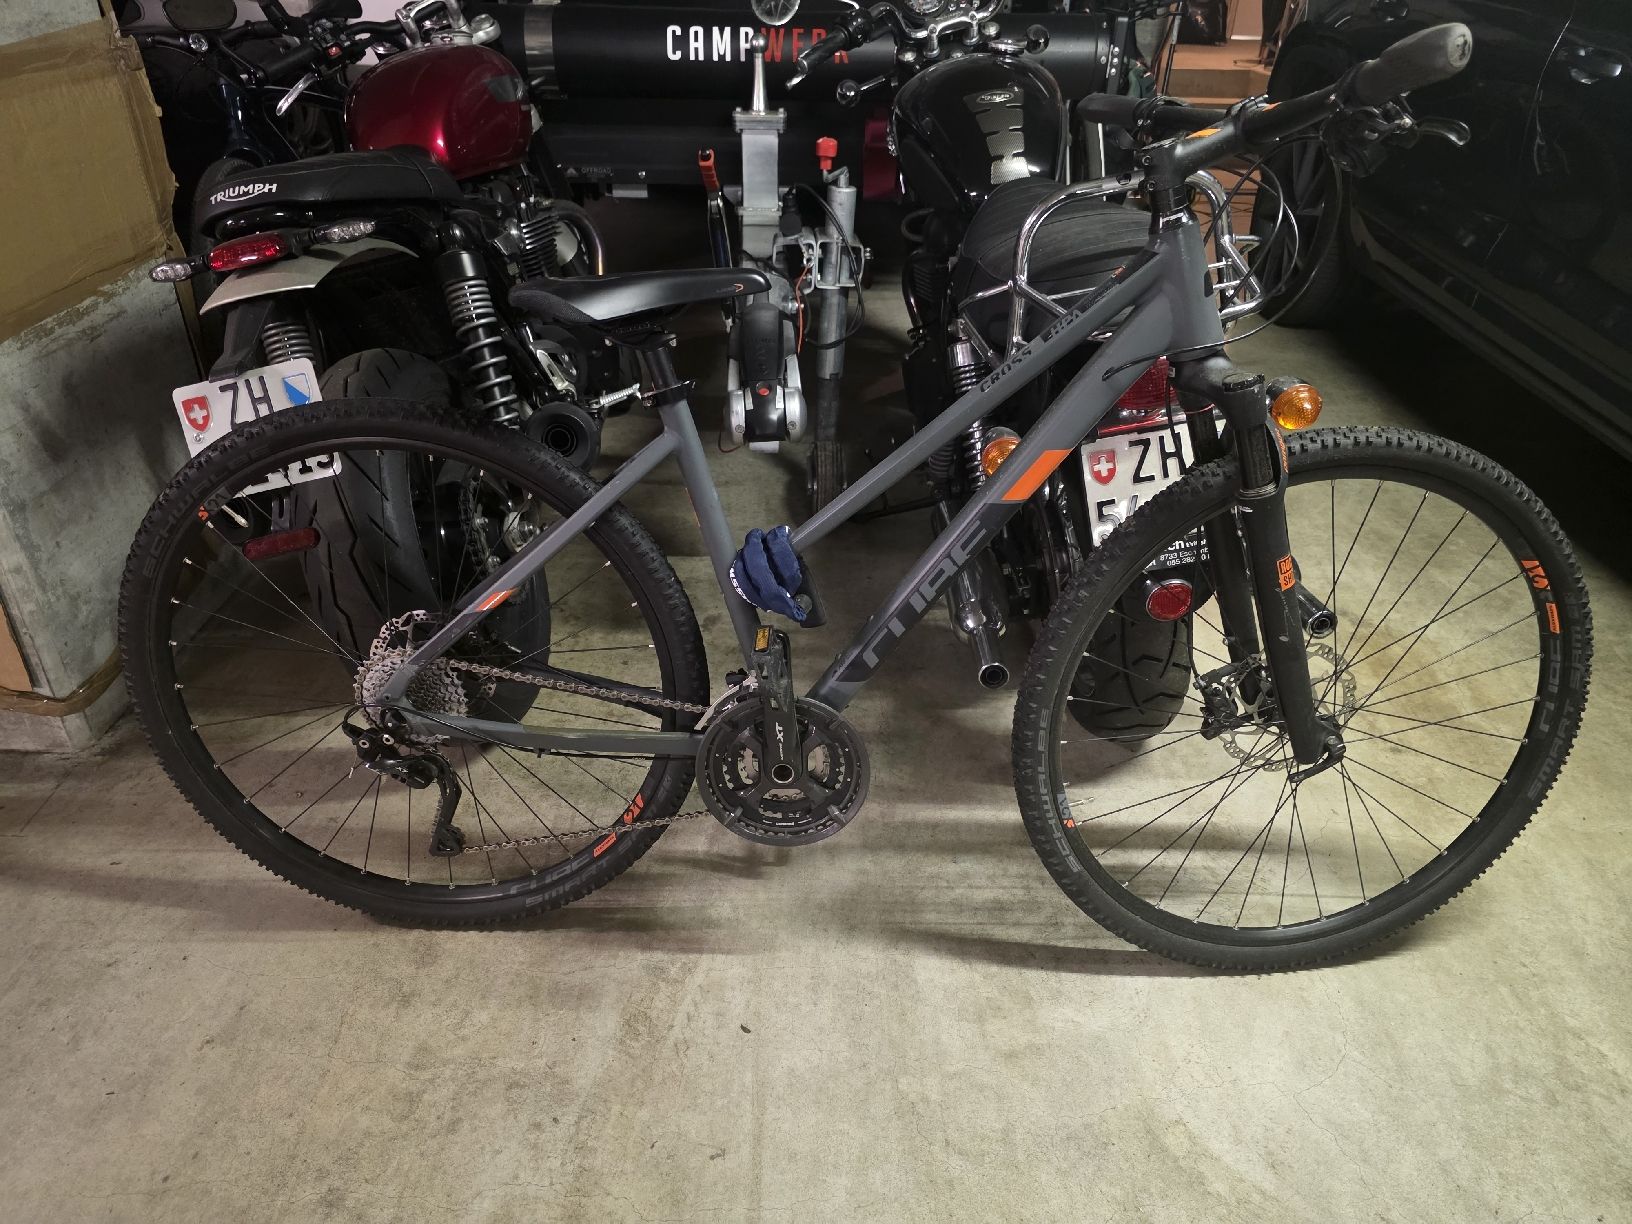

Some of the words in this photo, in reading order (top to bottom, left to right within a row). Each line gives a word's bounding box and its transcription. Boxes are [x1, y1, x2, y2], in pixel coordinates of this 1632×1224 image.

[210, 183, 278, 205] TRIUMPH
[980, 348, 1031, 392] CROSS
[1128, 432, 1187, 483] ZH
[1160, 552, 1177, 561] 8733
[776, 722, 784, 742] XT
[1037, 708, 1083, 873] SCHWALBE
